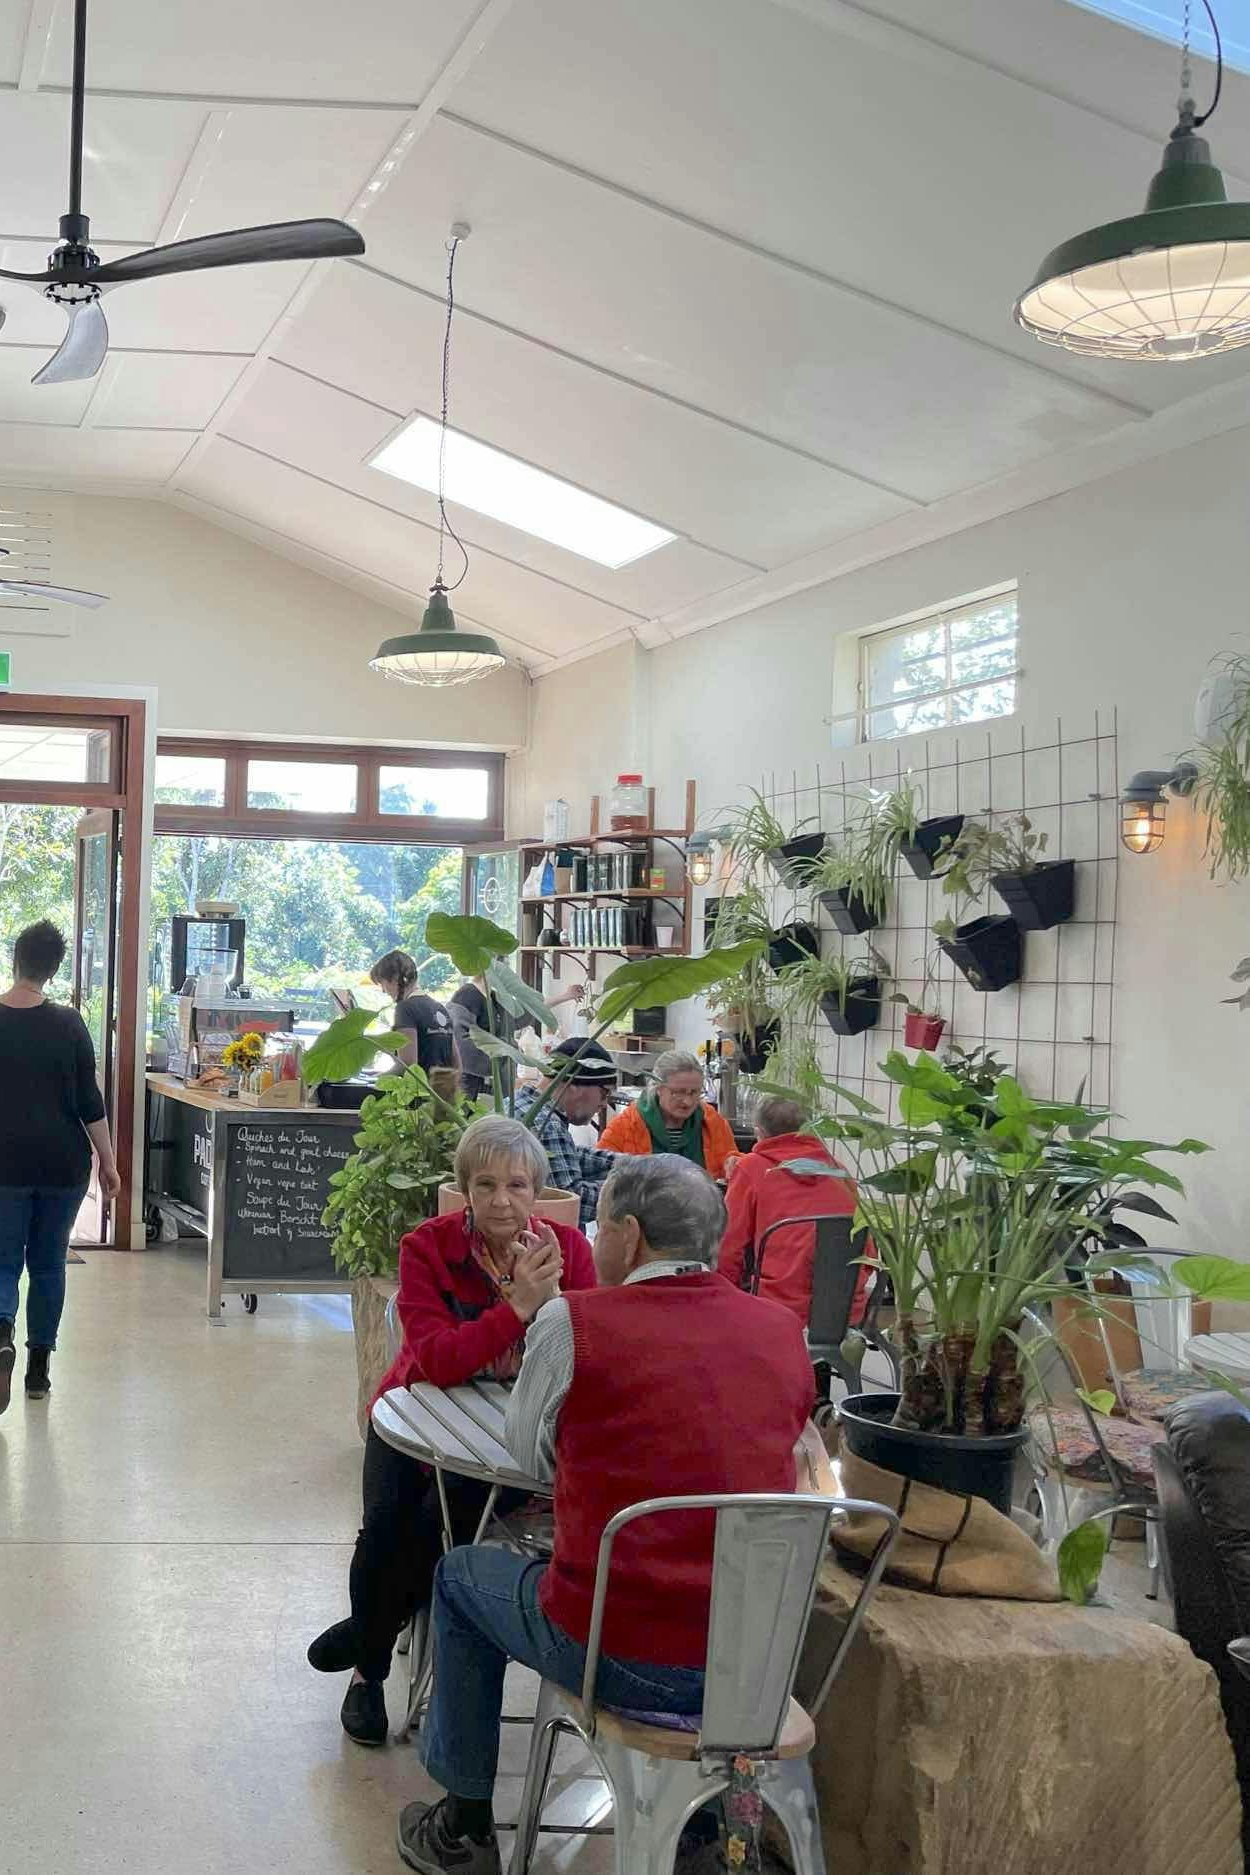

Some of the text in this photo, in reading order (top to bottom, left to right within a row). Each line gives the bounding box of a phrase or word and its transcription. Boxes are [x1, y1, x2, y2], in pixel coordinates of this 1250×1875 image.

[237, 1126, 320, 1143] Quiches du Jour
[244, 1141, 276, 1154] Spinach
[279, 1146, 296, 1157] and
[246, 1155, 266, 1167] Ham
[271, 1160, 290, 1170] and
[246, 1172, 274, 1190] Vegan
[276, 1194, 290, 1207] du
[295, 1196, 323, 1211] Jour
